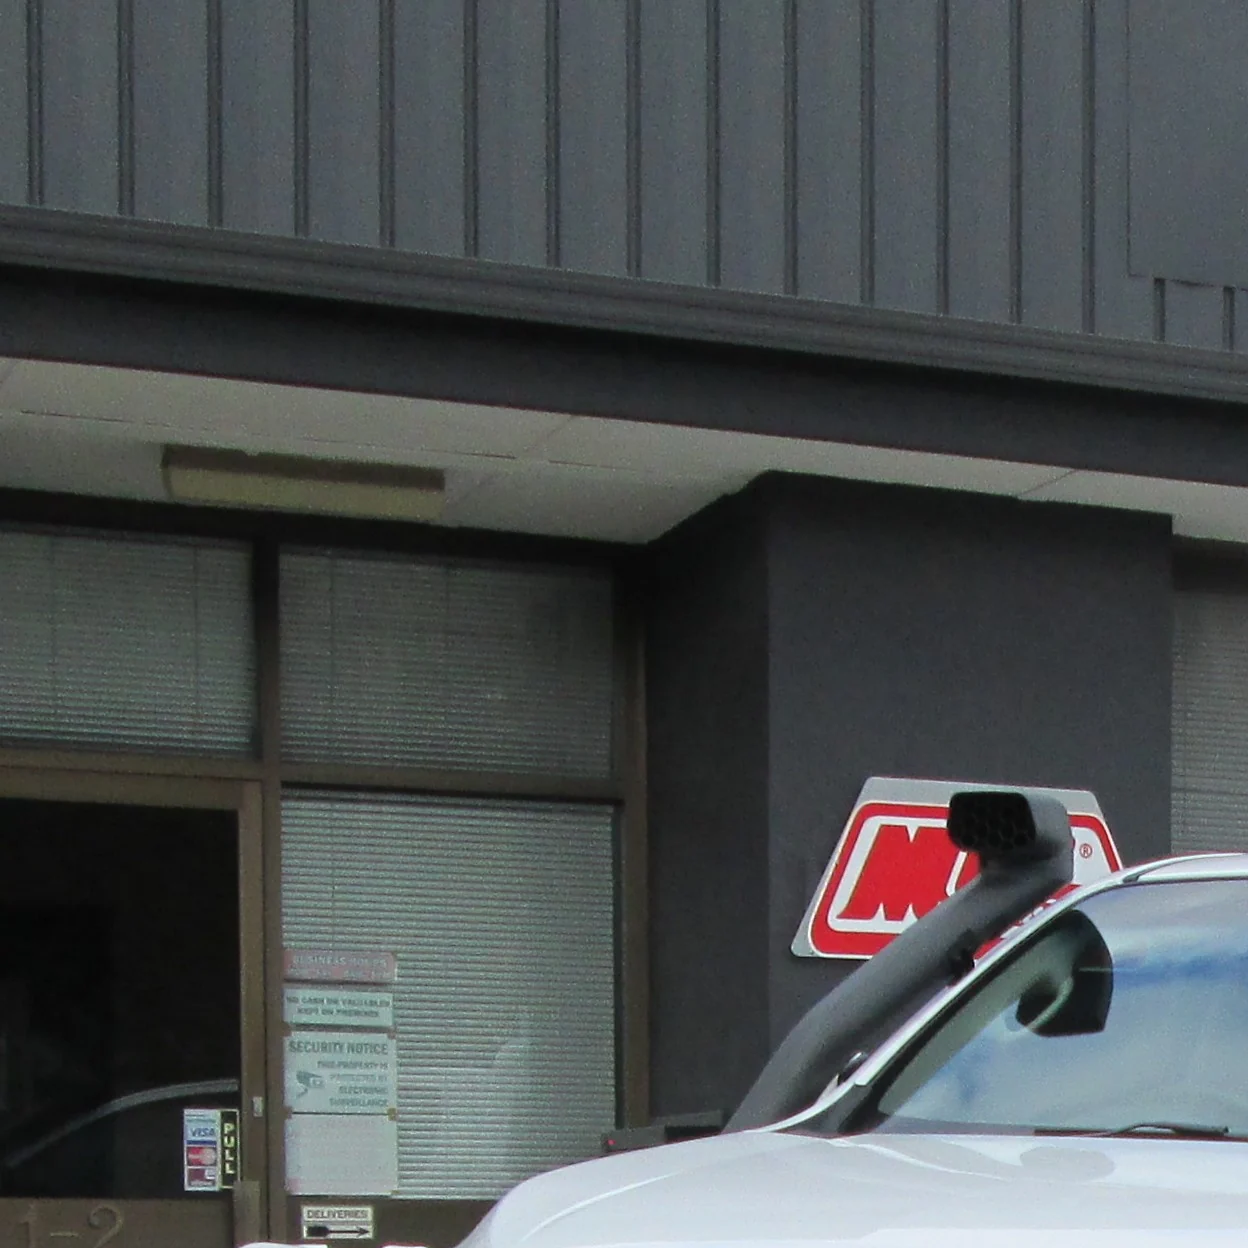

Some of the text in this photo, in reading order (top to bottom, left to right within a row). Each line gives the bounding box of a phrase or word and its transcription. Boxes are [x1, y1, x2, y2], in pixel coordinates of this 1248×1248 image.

[288, 1041, 389, 1055] SECURITY NOTICE
[190, 1127, 215, 1137] VISA
[223, 1122, 235, 1174] PULL
[306, 1208, 369, 1219] DELIVERIES
